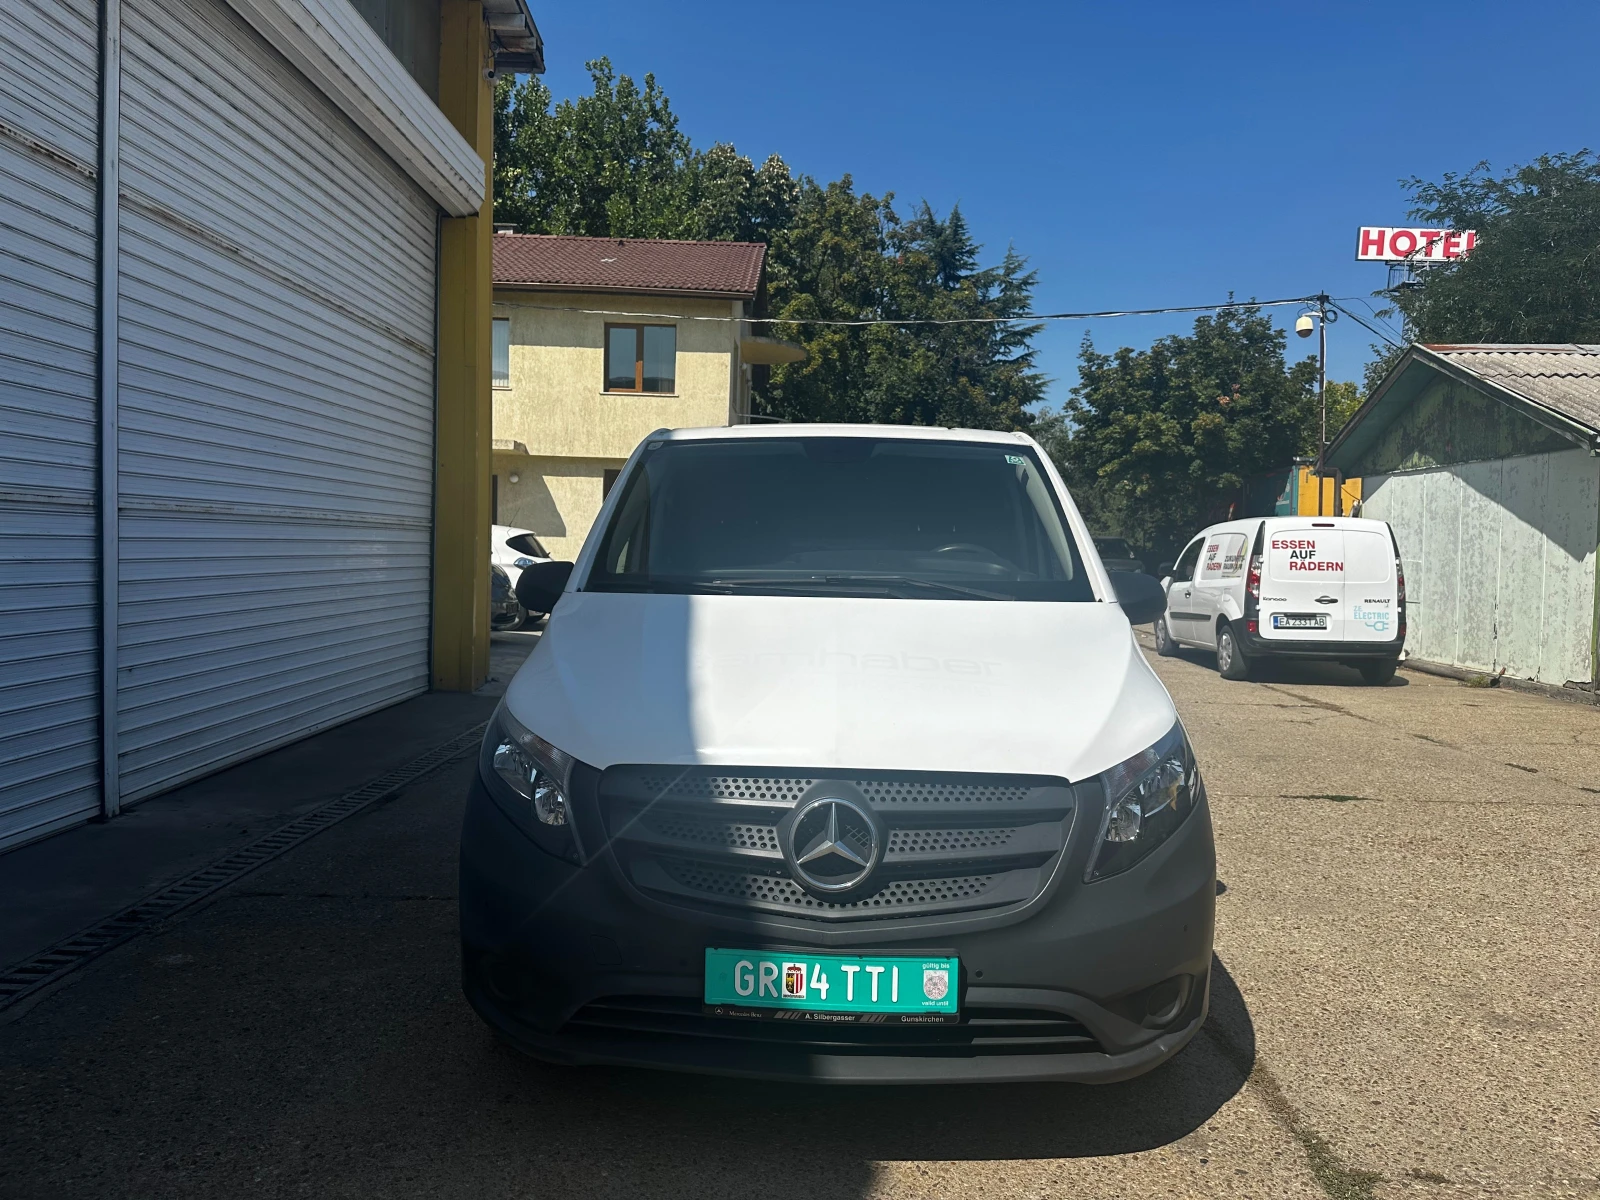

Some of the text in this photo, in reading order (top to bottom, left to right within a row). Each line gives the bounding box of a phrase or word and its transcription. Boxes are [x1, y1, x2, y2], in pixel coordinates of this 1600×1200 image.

[1271, 539, 1316, 550] ESSEN
[1290, 550, 1317, 560] AUF
[1289, 559, 1344, 571] RÄDERN
[1353, 612, 1390, 620] ELECTRIC
[1292, 618, 1312, 626] 2331
[1314, 618, 1325, 626] AB
[922, 962, 940, 970] gültig
[734, 960, 899, 1003] GR 4 TTI
[813, 1013, 856, 1022] Silbergasser
[900, 1015, 944, 1023] Gunskirchen
